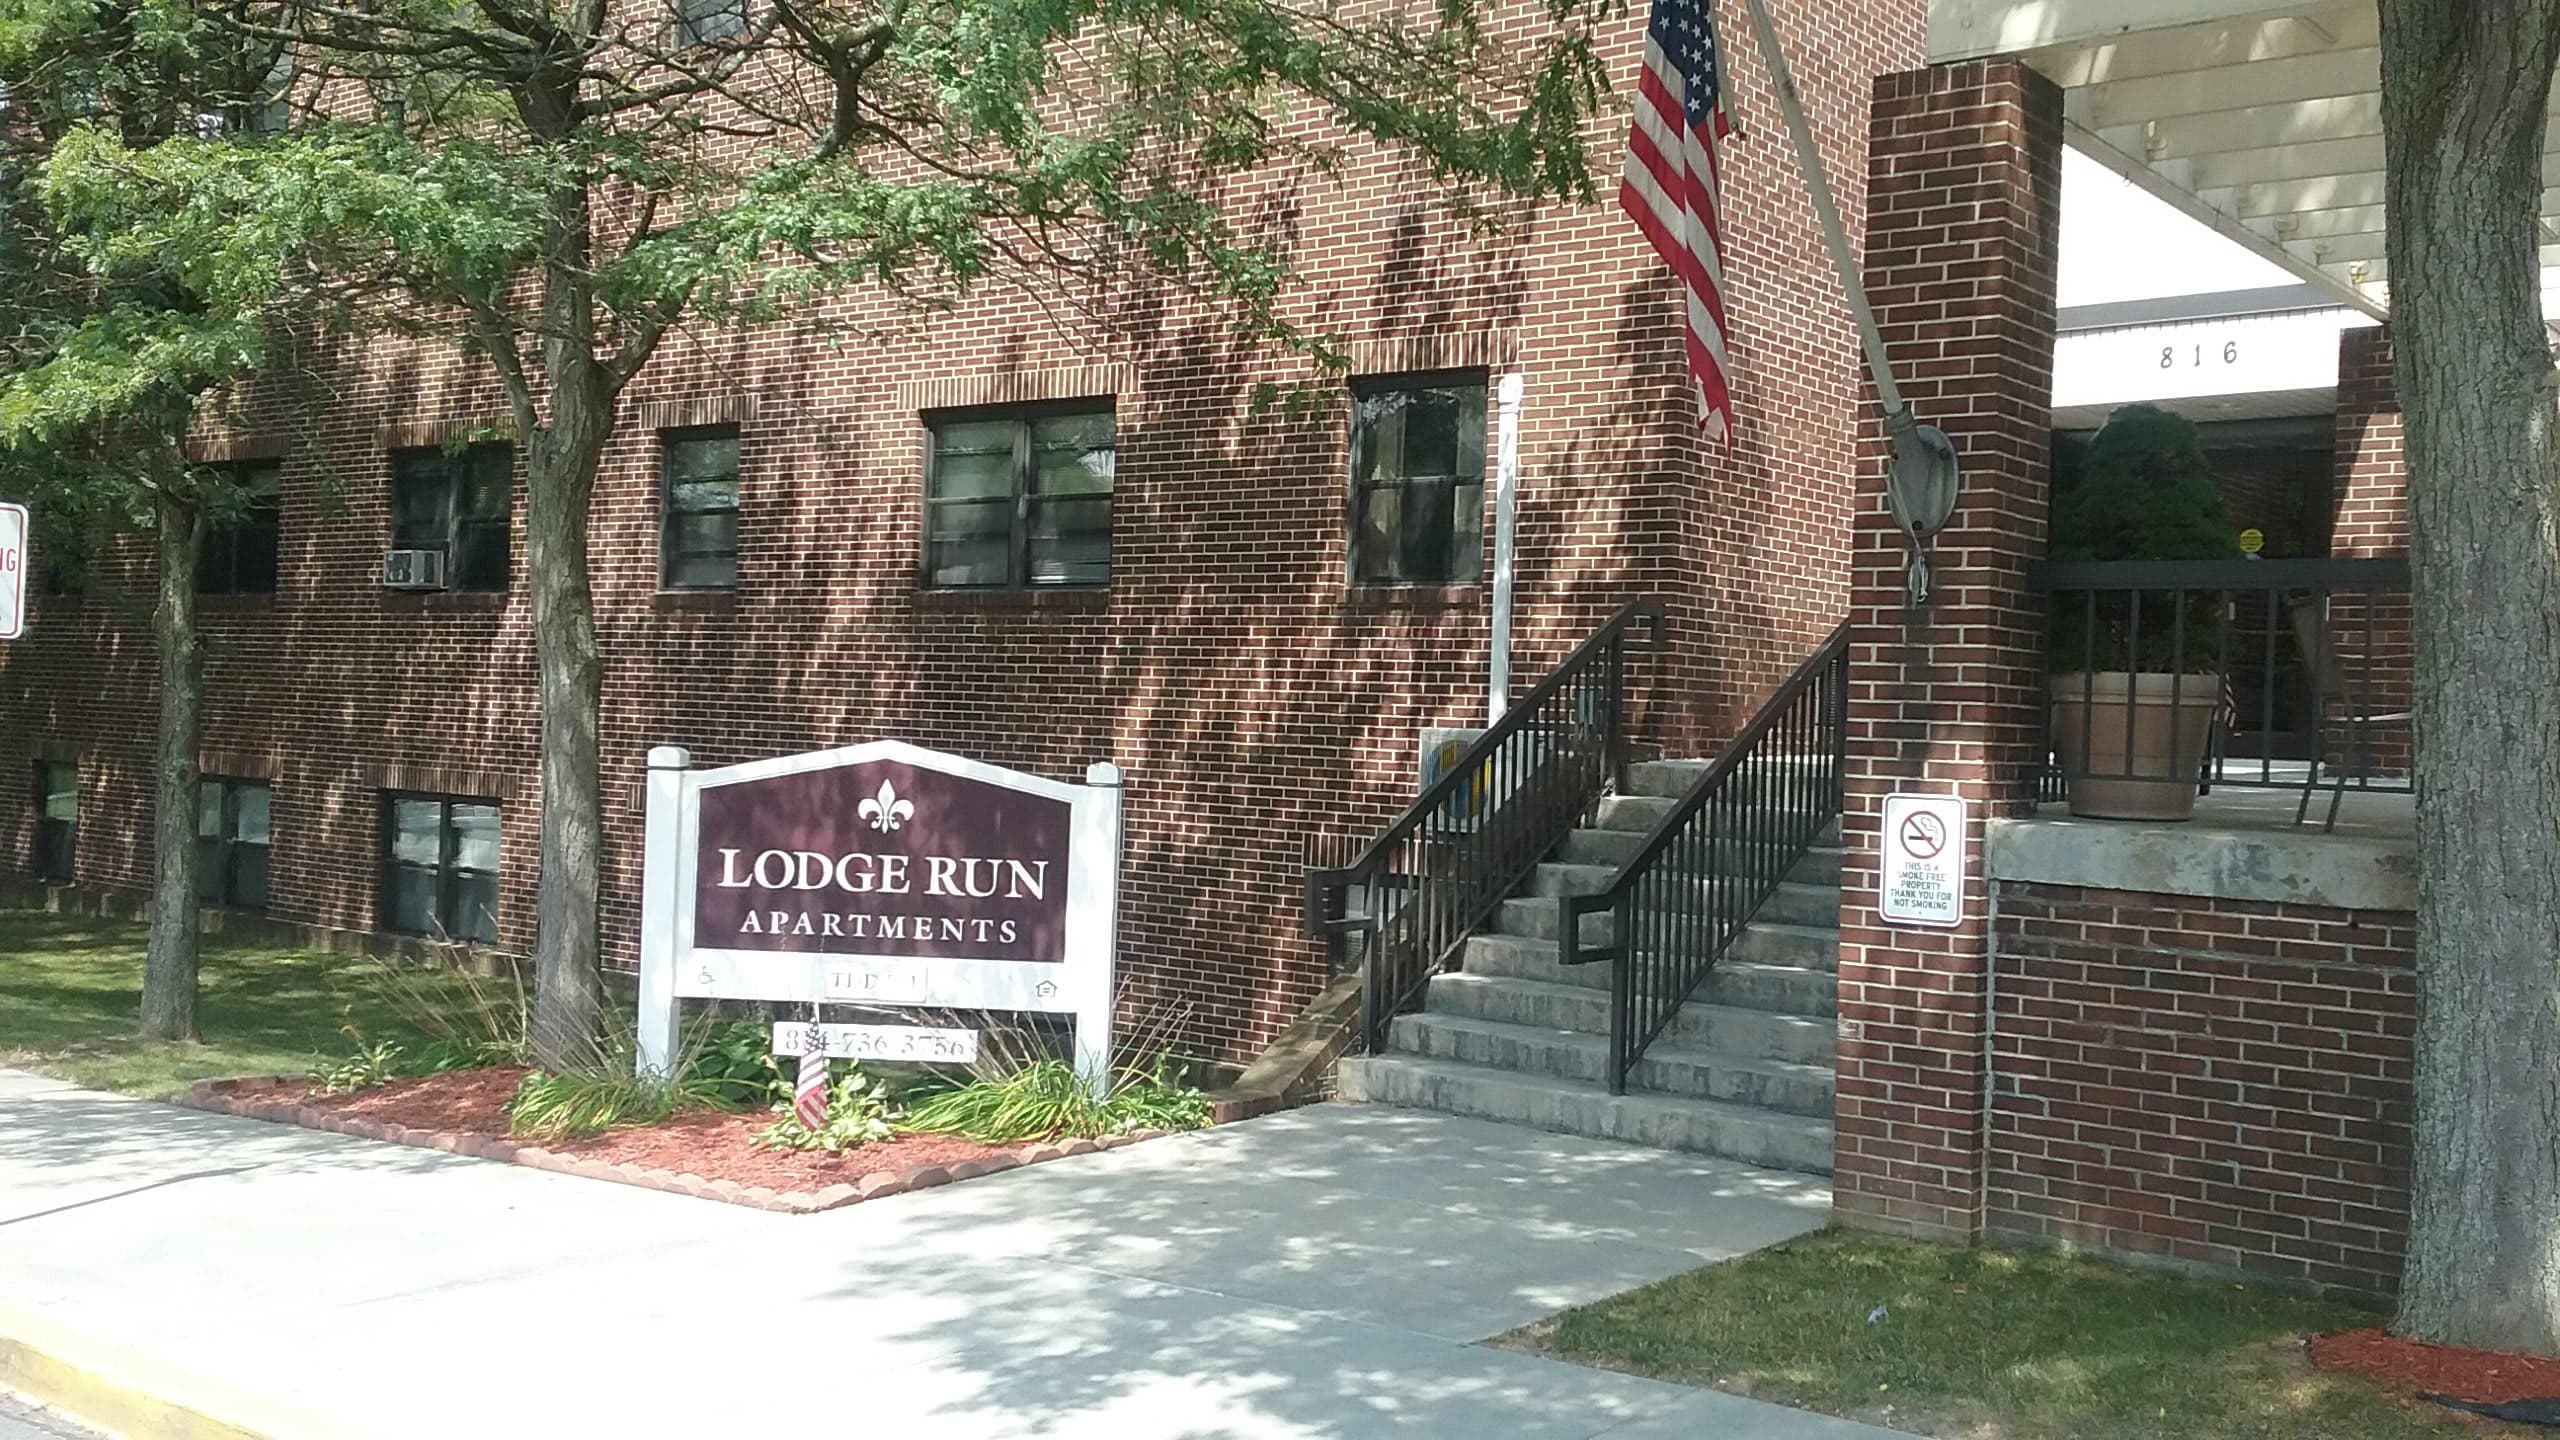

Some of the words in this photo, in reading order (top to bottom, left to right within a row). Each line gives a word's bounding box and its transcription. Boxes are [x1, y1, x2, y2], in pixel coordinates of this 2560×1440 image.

[2160, 341, 2237, 368] 816
[1904, 862, 1921, 870] THIS
[1924, 863, 1931, 871] IS
[717, 848, 911, 894] LODGE
[924, 856, 1049, 901] RUN
[1898, 871, 1924, 880] SMOKE
[1926, 873, 1946, 882] FREE
[1900, 880, 1940, 890] PROPERTY
[1890, 888, 1916, 897] THANK
[1918, 890, 1934, 900] YOU
[1936, 892, 1952, 901] FOR
[1894, 898, 1909, 907] NOT
[1911, 900, 1947, 910] SMOKING
[740, 909, 1017, 944] APARTMENTS
